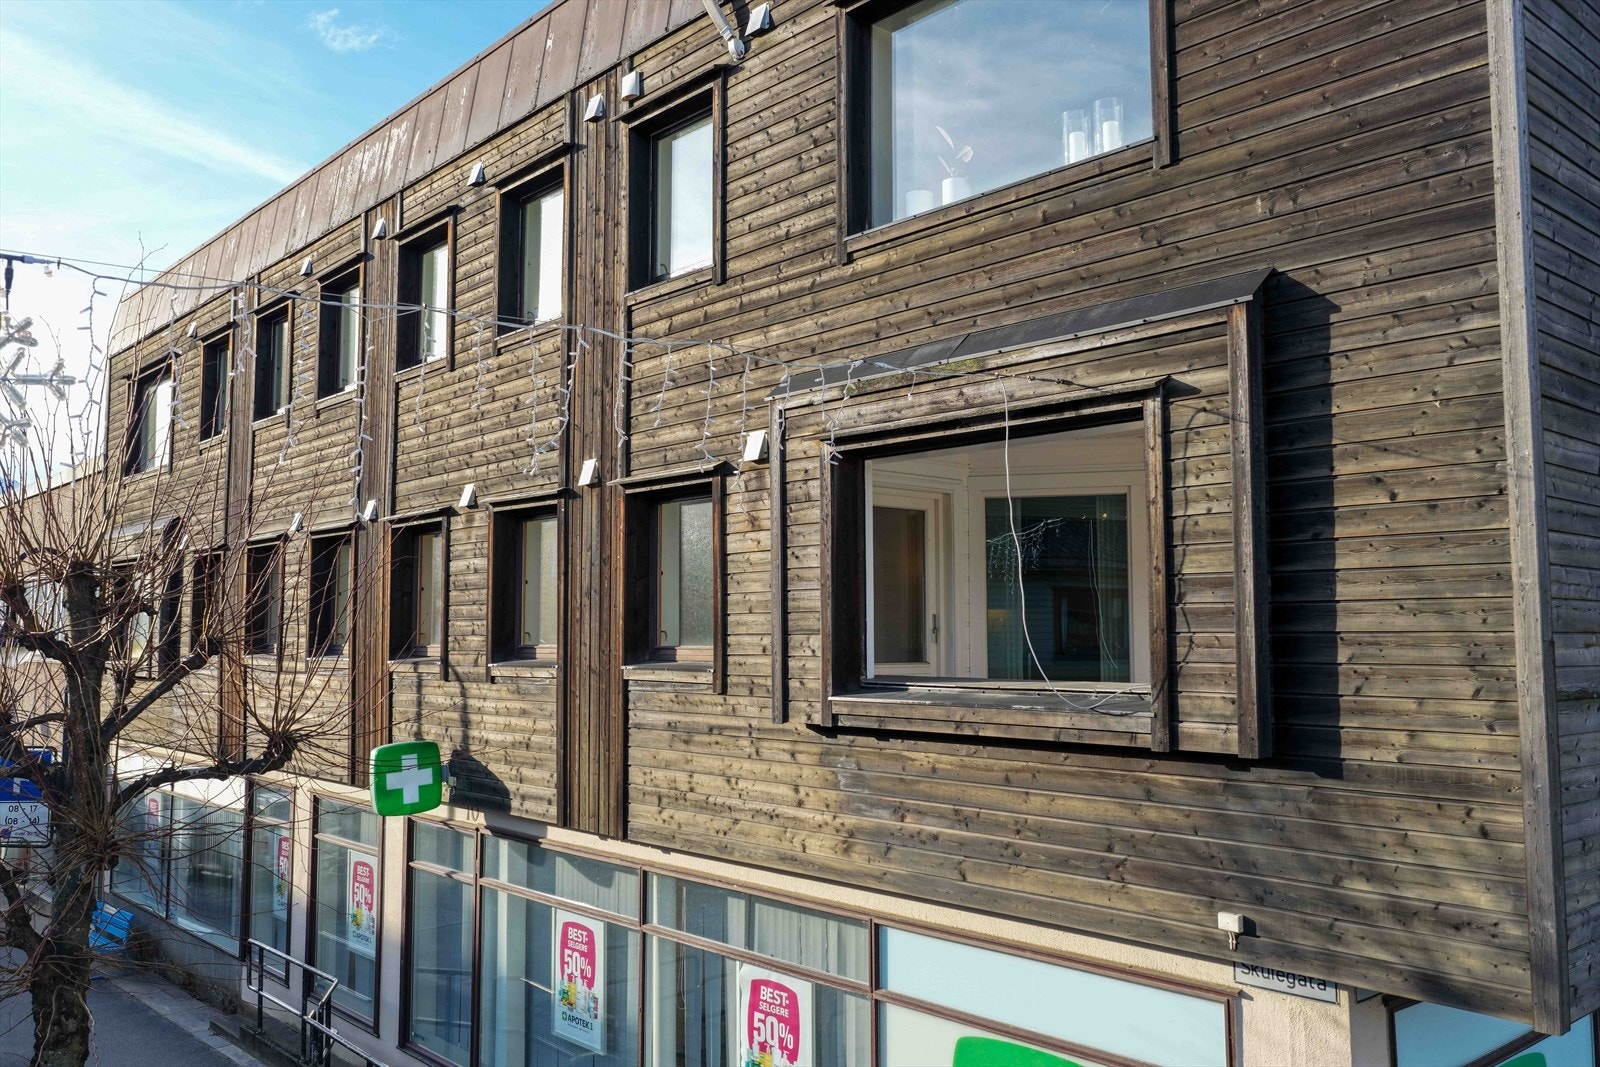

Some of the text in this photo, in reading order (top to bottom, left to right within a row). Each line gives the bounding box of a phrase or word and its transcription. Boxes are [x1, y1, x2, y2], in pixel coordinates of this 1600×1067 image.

[5, 816, 18, 825] (08
[354, 882, 372, 904] 50%
[568, 927, 588, 943] BEST-
[567, 940, 588, 952] SELGERE
[564, 948, 592, 978] 50%
[760, 985, 789, 1007] BEST-
[759, 1001, 789, 1018] SELGERE
[567, 1014, 590, 1030] APOTEK
[590, 1022, 594, 1031] 1
[753, 1011, 794, 1050] 50%
